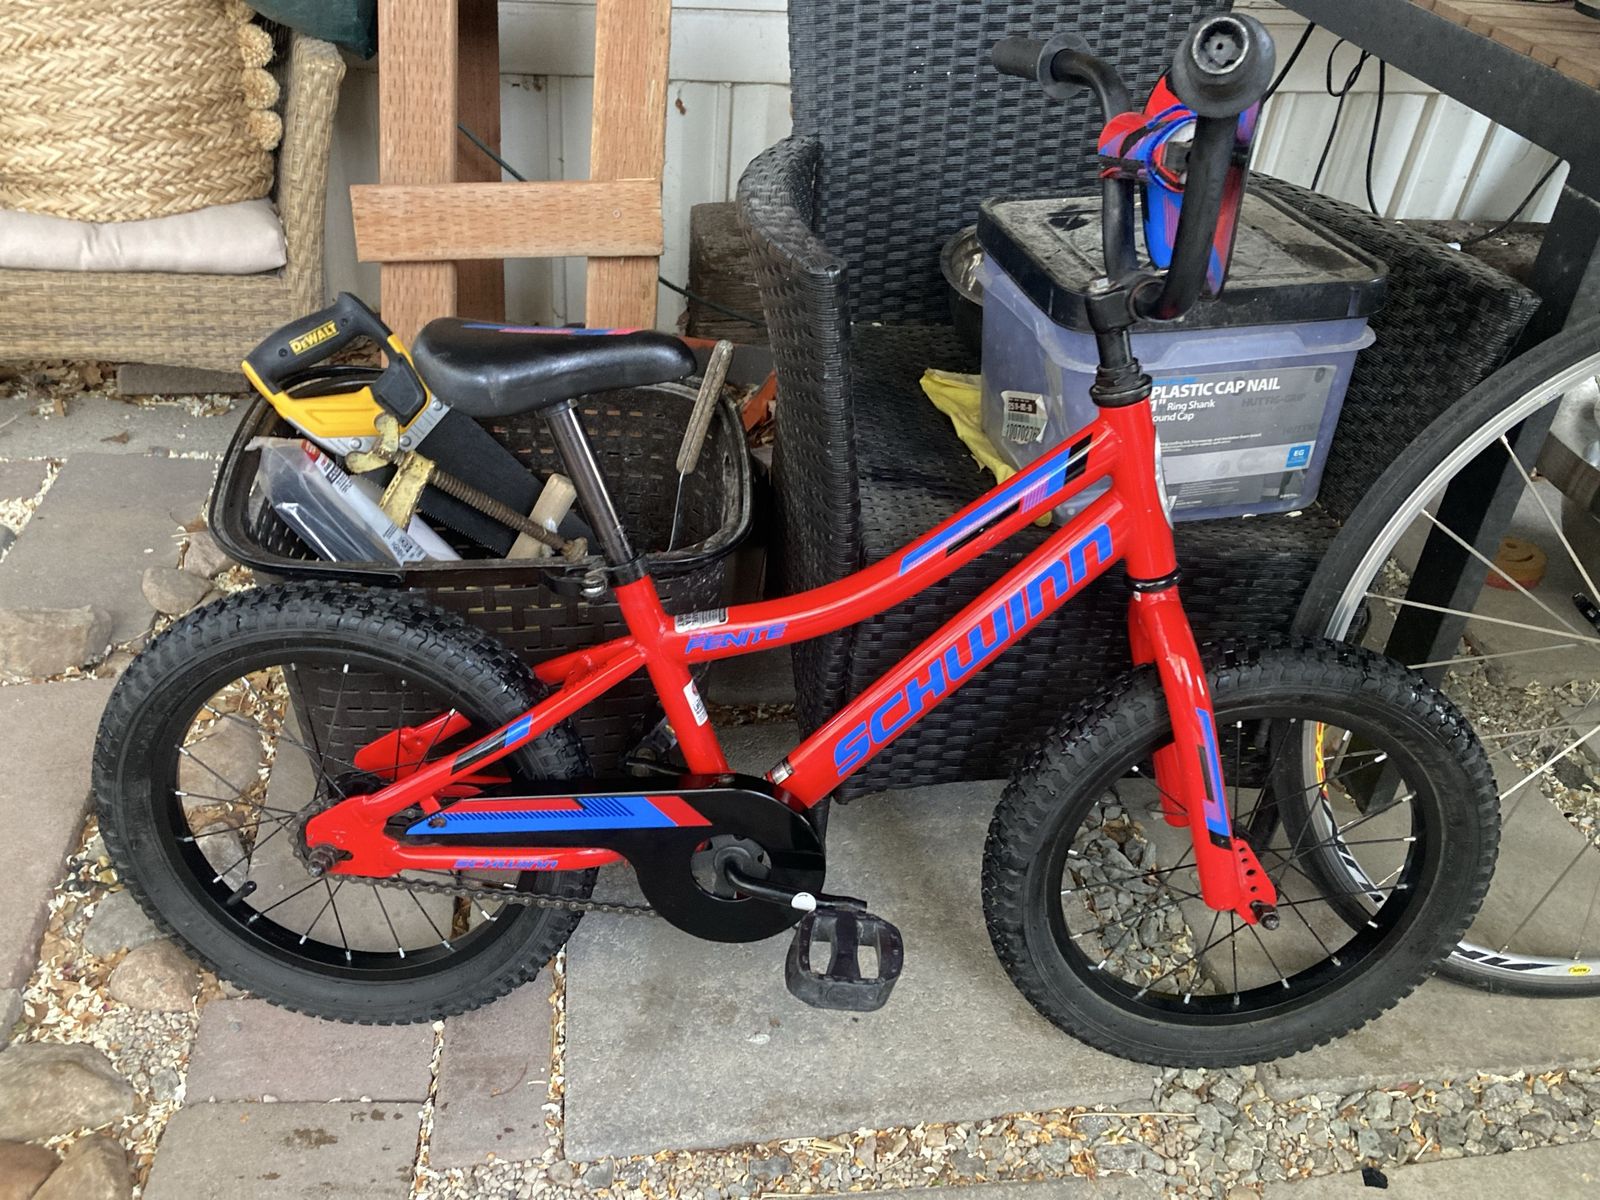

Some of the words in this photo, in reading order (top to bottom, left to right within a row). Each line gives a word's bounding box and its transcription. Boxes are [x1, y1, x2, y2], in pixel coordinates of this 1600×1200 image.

[1151, 383, 1212, 398] PLASTIC
[1214, 379, 1246, 394] CAP
[1247, 377, 1281, 392] NAIL
[1167, 402, 1188, 413] Ring
[1188, 399, 1216, 410] Shank
[1152, 414, 1176, 422] ound
[1177, 412, 1194, 421] Cap
[1293, 449, 1305, 457] EG
[834, 523, 1113, 776] SCHWINN
